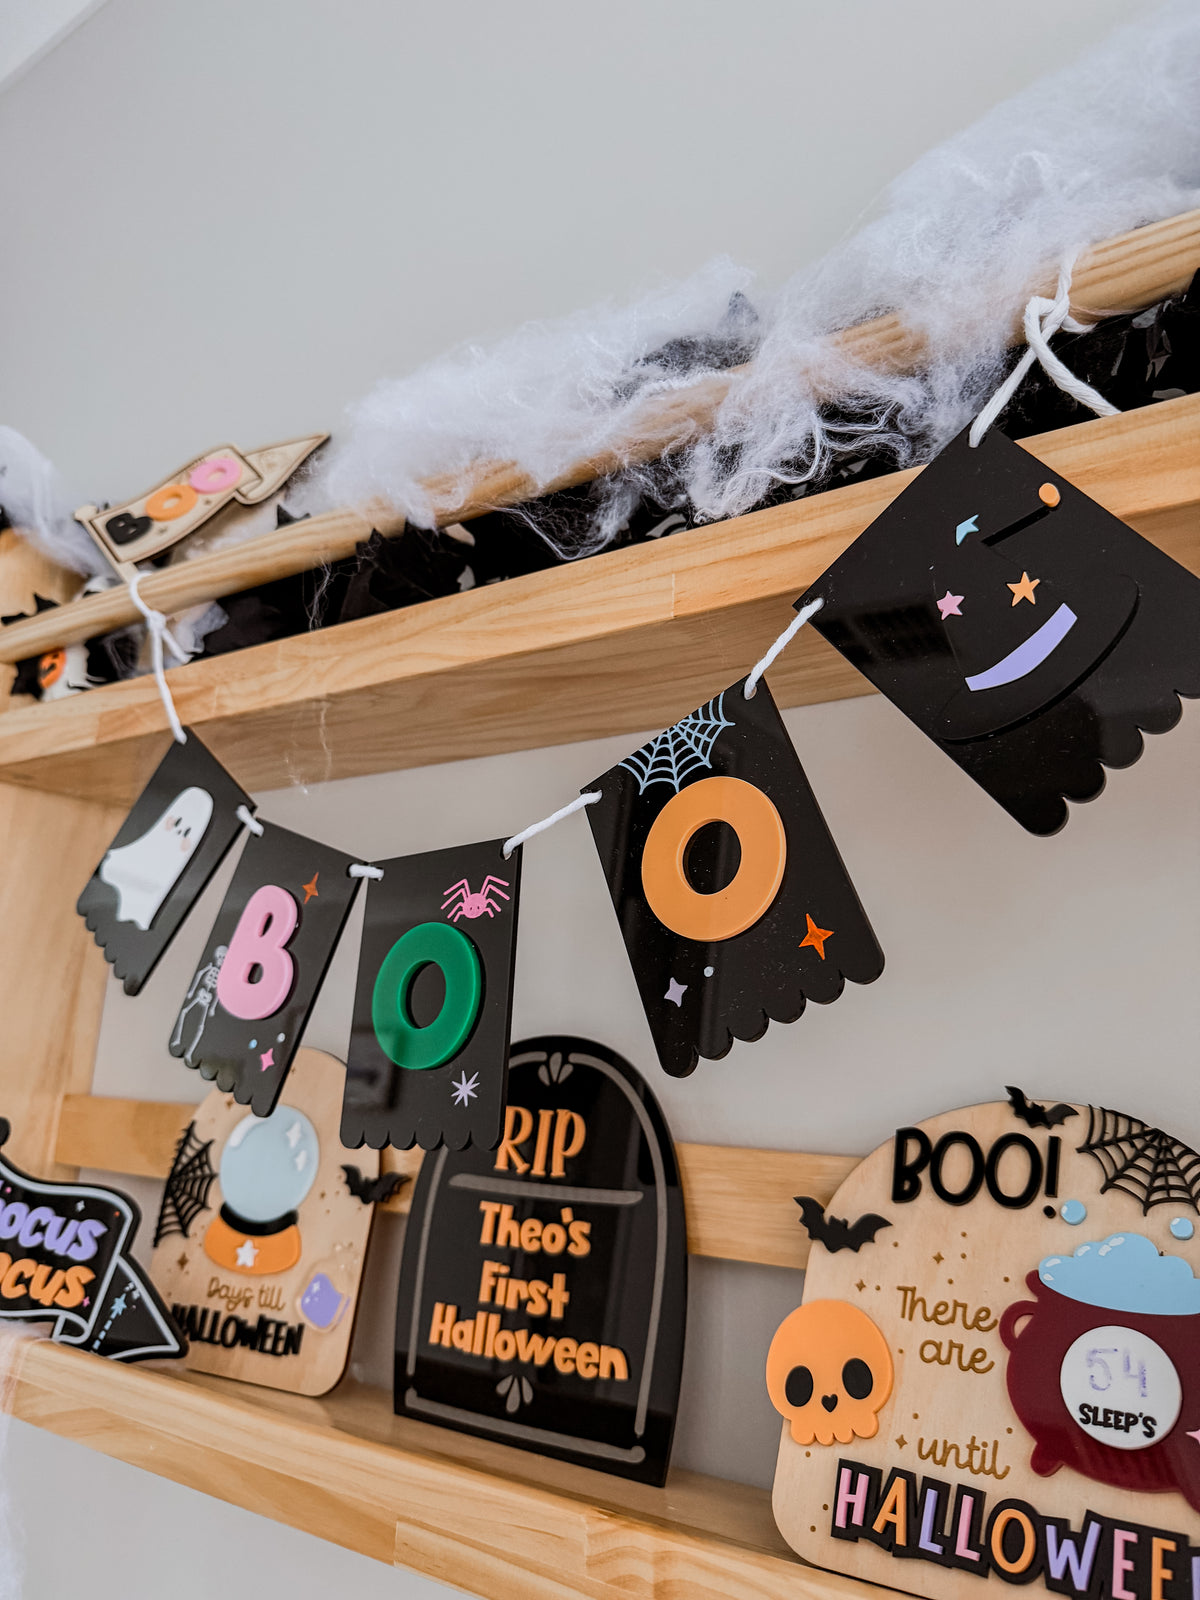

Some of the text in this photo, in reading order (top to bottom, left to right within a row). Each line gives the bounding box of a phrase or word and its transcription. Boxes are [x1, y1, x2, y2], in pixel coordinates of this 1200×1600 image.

[494, 1105, 586, 1177] RIP
[892, 1127, 1062, 1218] BOO!
[0, 1197, 108, 1261] OCUS
[479, 1201, 592, 1258] Theo's
[0, 1252, 96, 1308] CUS
[478, 1260, 570, 1319] First
[897, 1286, 999, 1333] There
[428, 1302, 630, 1381] Halloween
[919, 1339, 995, 1374] are
[1085, 1347, 1148, 1398] 54
[1078, 1403, 1158, 1439] SLEEP'S
[917, 1435, 1010, 1480] until
[834, 1466, 1200, 1600] HALLOWEE
